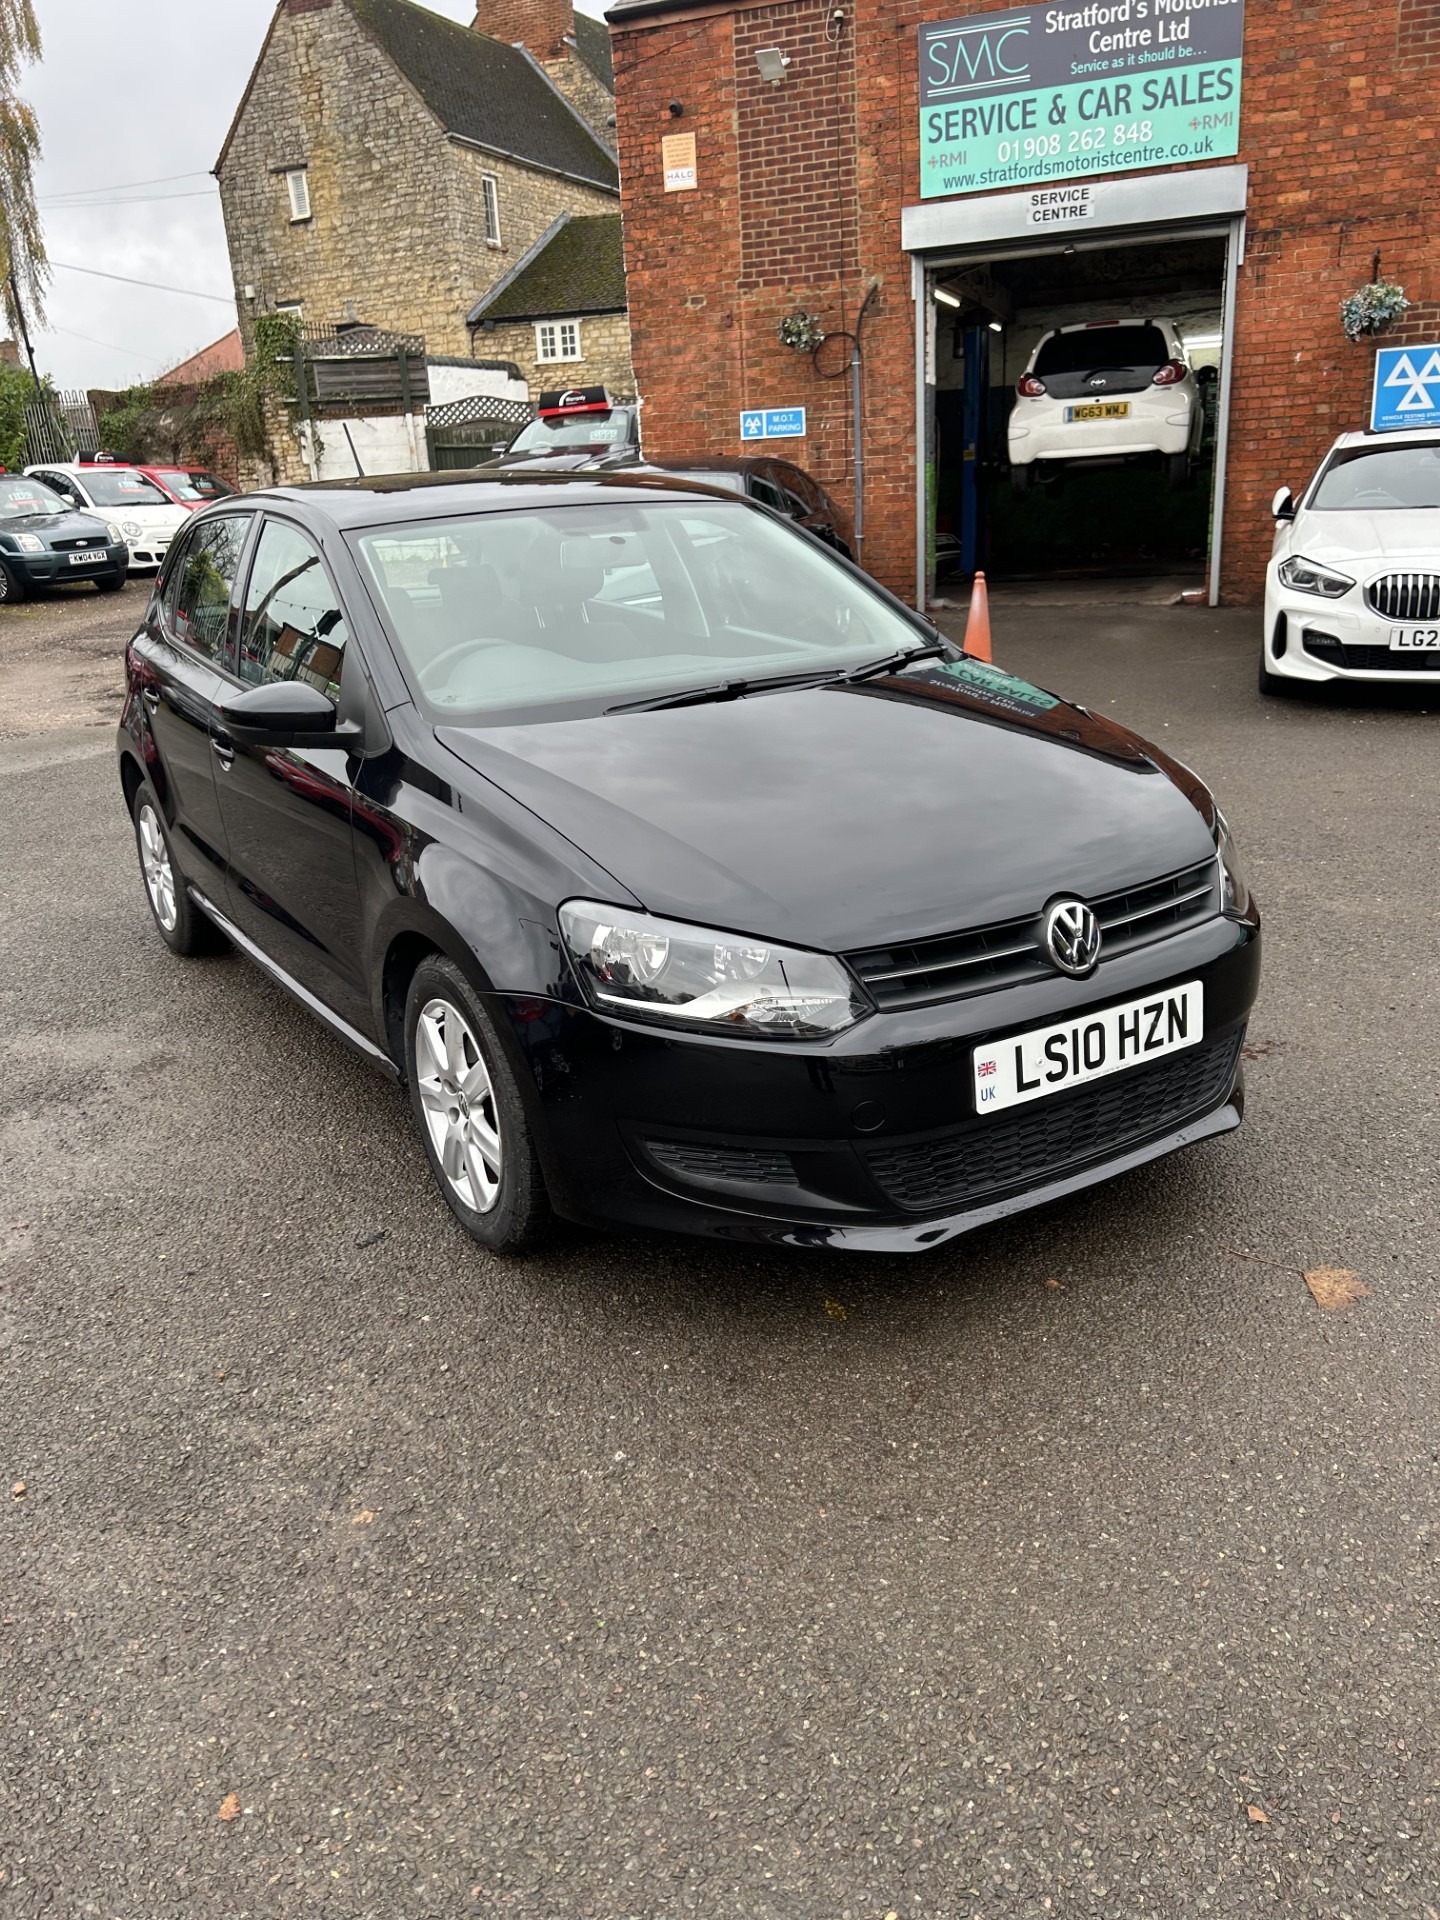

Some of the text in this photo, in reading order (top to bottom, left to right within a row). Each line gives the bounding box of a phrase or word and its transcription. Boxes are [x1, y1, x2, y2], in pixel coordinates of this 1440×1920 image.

[1045, 0, 1148, 33] Stratford's
[1089, 16, 1190, 53] Centre Ltd
[928, 29, 1029, 85] SMC
[1071, 59, 1109, 75] Service
[1111, 57, 1125, 69] as
[1127, 53, 1135, 66] it
[1137, 46, 1175, 64] should
[928, 67, 1233, 144] SERVICE & CAR SALES
[1202, 111, 1233, 130] RMI
[997, 120, 1153, 163] 01908 262 848
[940, 150, 967, 168] RMI
[943, 136, 1213, 189] www.stratfordsmotoristcentre.co.uk
[1031, 188, 1090, 206] SERVICE
[1033, 204, 1087, 222] CENTRE
[768, 423, 801, 432] PARKING
[1398, 630, 1440, 647] LG2
[1014, 993, 1188, 1093] LS10 HZN
[980, 1085, 996, 1102] UK
